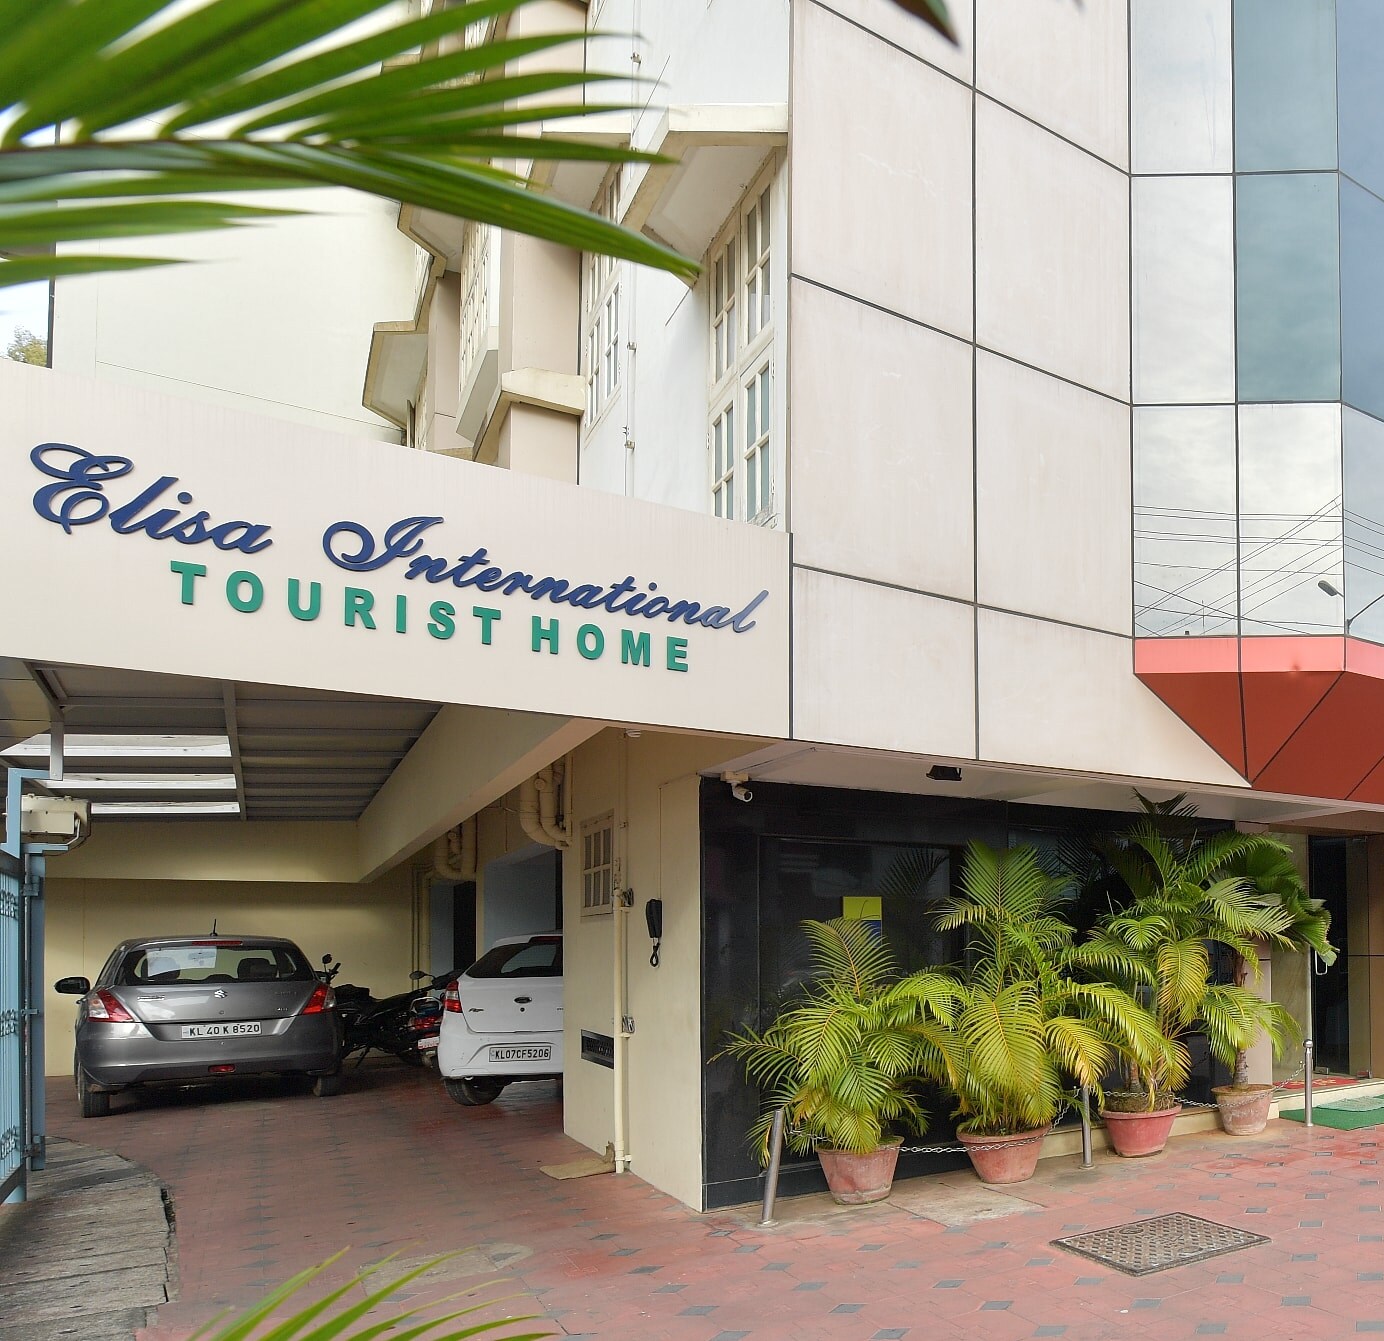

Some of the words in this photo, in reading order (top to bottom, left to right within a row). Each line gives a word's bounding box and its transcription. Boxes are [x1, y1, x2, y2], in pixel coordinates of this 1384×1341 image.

[29, 442, 273, 554] Elisa
[322, 515, 769, 634] International
[171, 561, 501, 644] TOURIST
[531, 616, 690, 672] HOME
[189, 1026, 204, 1036] KL
[206, 1026, 220, 1035] 40
[223, 1026, 230, 1035] K
[232, 1023, 260, 1034] 8520
[494, 1048, 549, 1060] KL07CF5206
